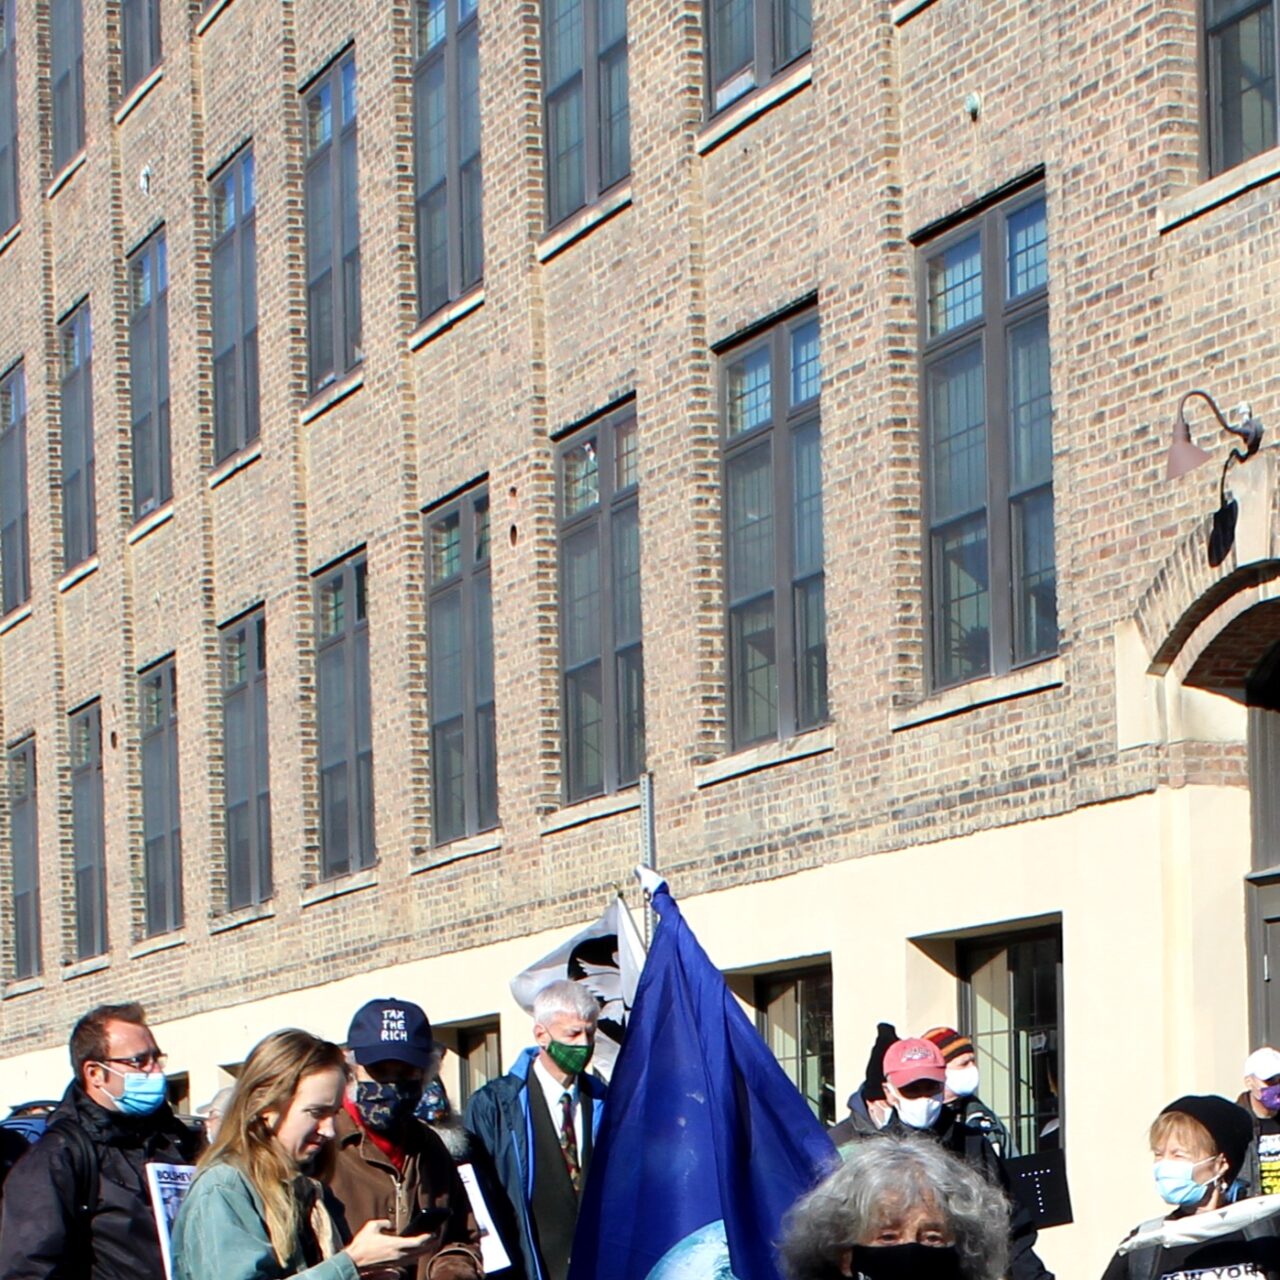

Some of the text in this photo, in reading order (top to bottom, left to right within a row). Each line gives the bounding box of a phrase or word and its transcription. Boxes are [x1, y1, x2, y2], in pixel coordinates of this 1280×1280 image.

[382, 1009, 405, 1019] TAX
[382, 1020, 405, 1030] THE
[381, 1030, 408, 1042] RICH
[1213, 1263, 1260, 1280] YOR
